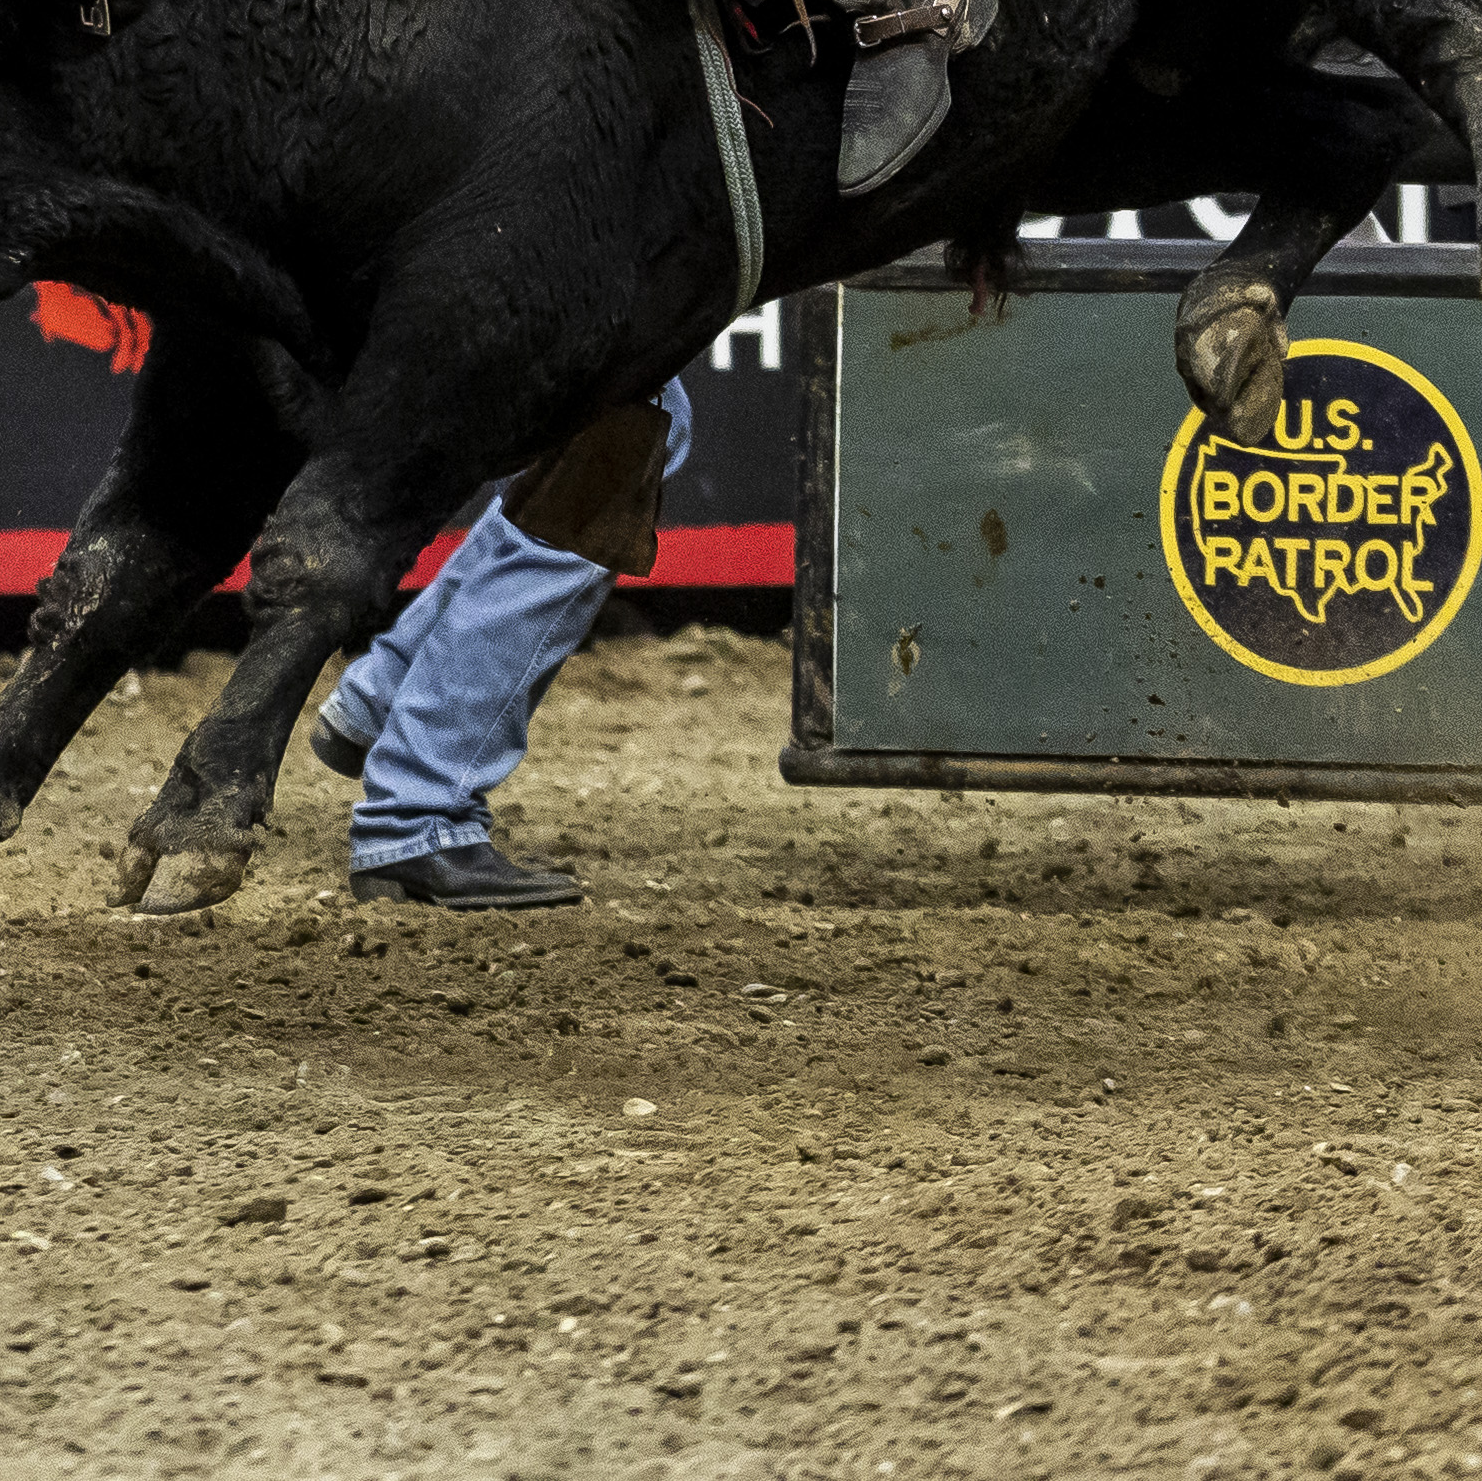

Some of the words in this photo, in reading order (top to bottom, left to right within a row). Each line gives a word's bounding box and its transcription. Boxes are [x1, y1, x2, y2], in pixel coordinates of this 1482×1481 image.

[1274, 398, 1374, 451] U.S.
[1204, 471, 1437, 525] BORDER
[1204, 536, 1435, 592] PATROL
